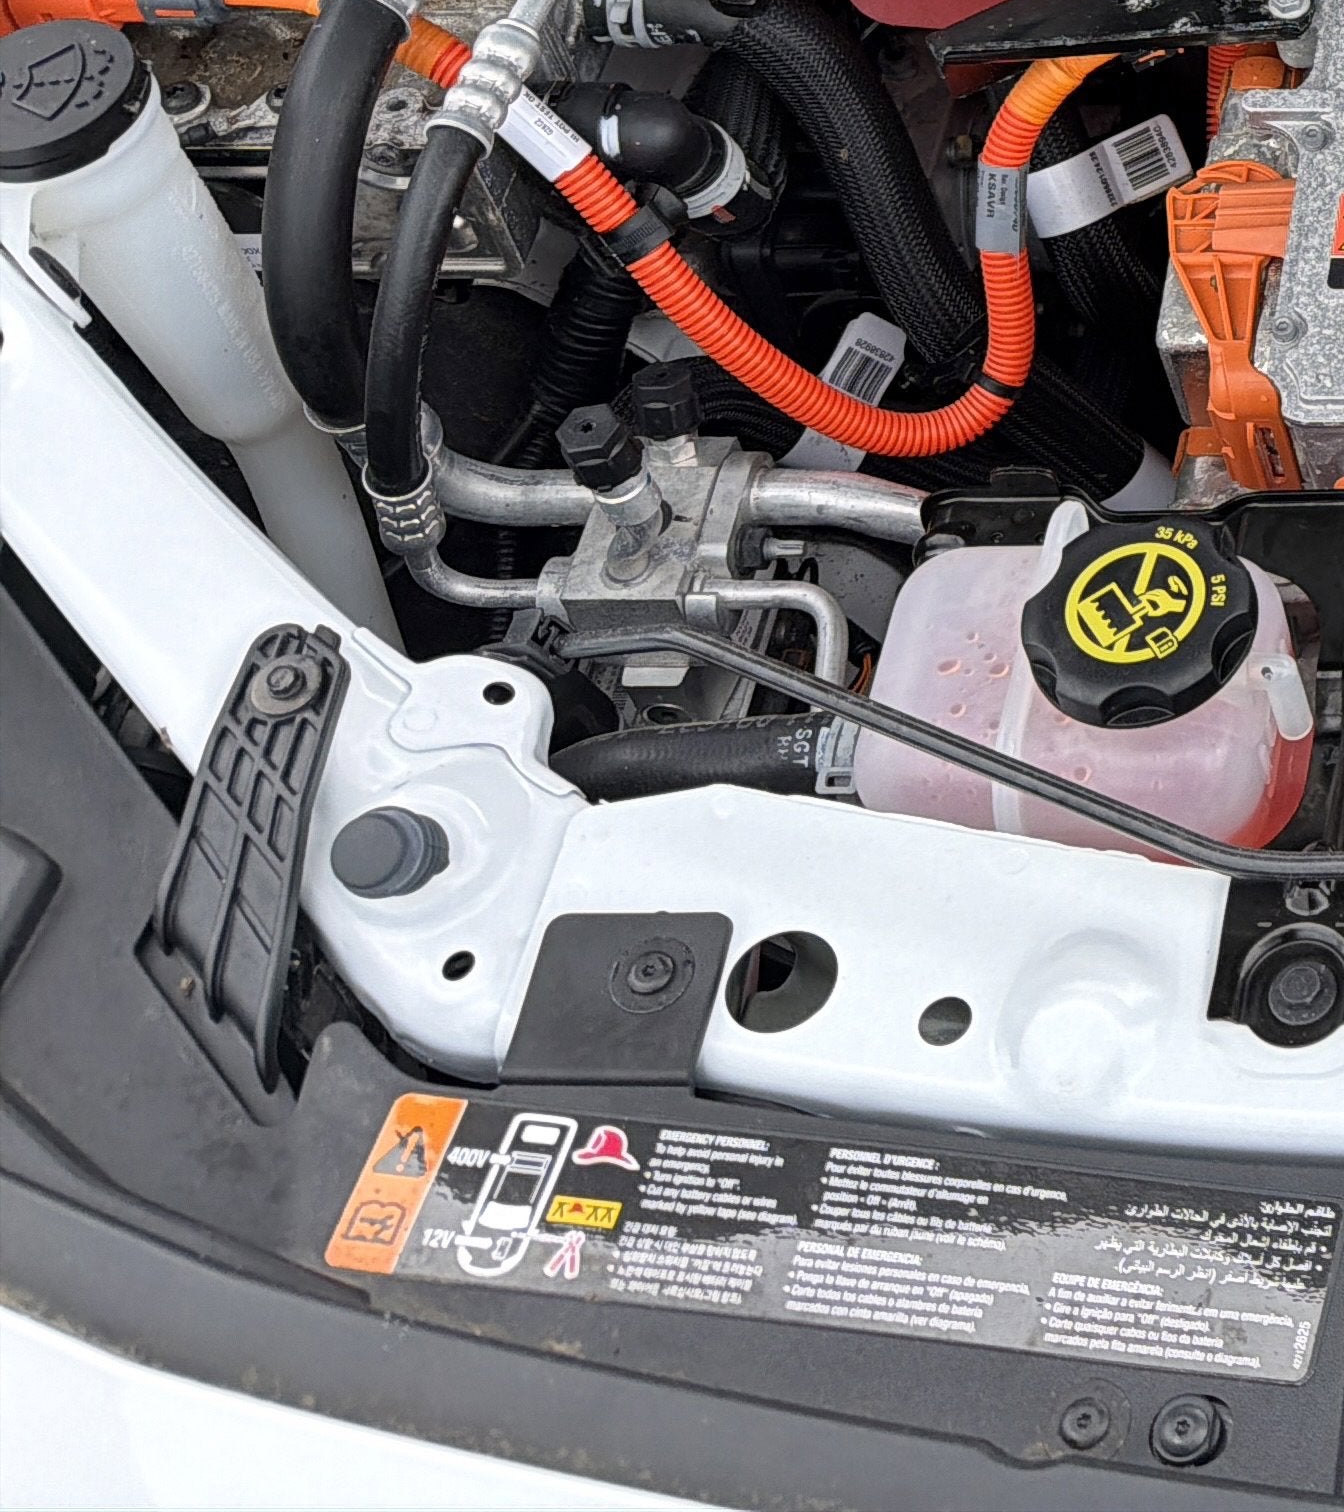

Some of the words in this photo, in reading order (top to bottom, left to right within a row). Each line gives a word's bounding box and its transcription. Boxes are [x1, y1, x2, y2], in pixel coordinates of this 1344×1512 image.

[986, 173, 997, 218] KSAVR
[1155, 526, 1173, 540] 35
[1174, 529, 1199, 550] kPa
[1211, 574, 1226, 584] 5
[1210, 585, 1228, 607] PSI
[792, 726, 810, 769] SGT
[659, 1129, 715, 1144] EMERGENCY
[448, 1146, 490, 1169] 400V
[829, 1147, 881, 1164] PERSONNEL
[824, 1160, 846, 1173] Pour
[992, 1182, 1005, 1192] en
[1004, 1184, 1022, 1195] cas
[422, 1228, 456, 1248] 12V
[796, 1240, 844, 1257] PERSONAL
[846, 1246, 860, 1258] DE
[792, 1254, 813, 1267] Para
[814, 1258, 840, 1270] evitar
[840, 1260, 877, 1275] lesiones
[877, 1266, 926, 1281] personales
[927, 1272, 940, 1282] en
[940, 1274, 962, 1285] caso
[962, 1275, 976, 1287] de
[1051, 1271, 1086, 1287] EQUIPE
[1086, 1276, 1100, 1288] DE
